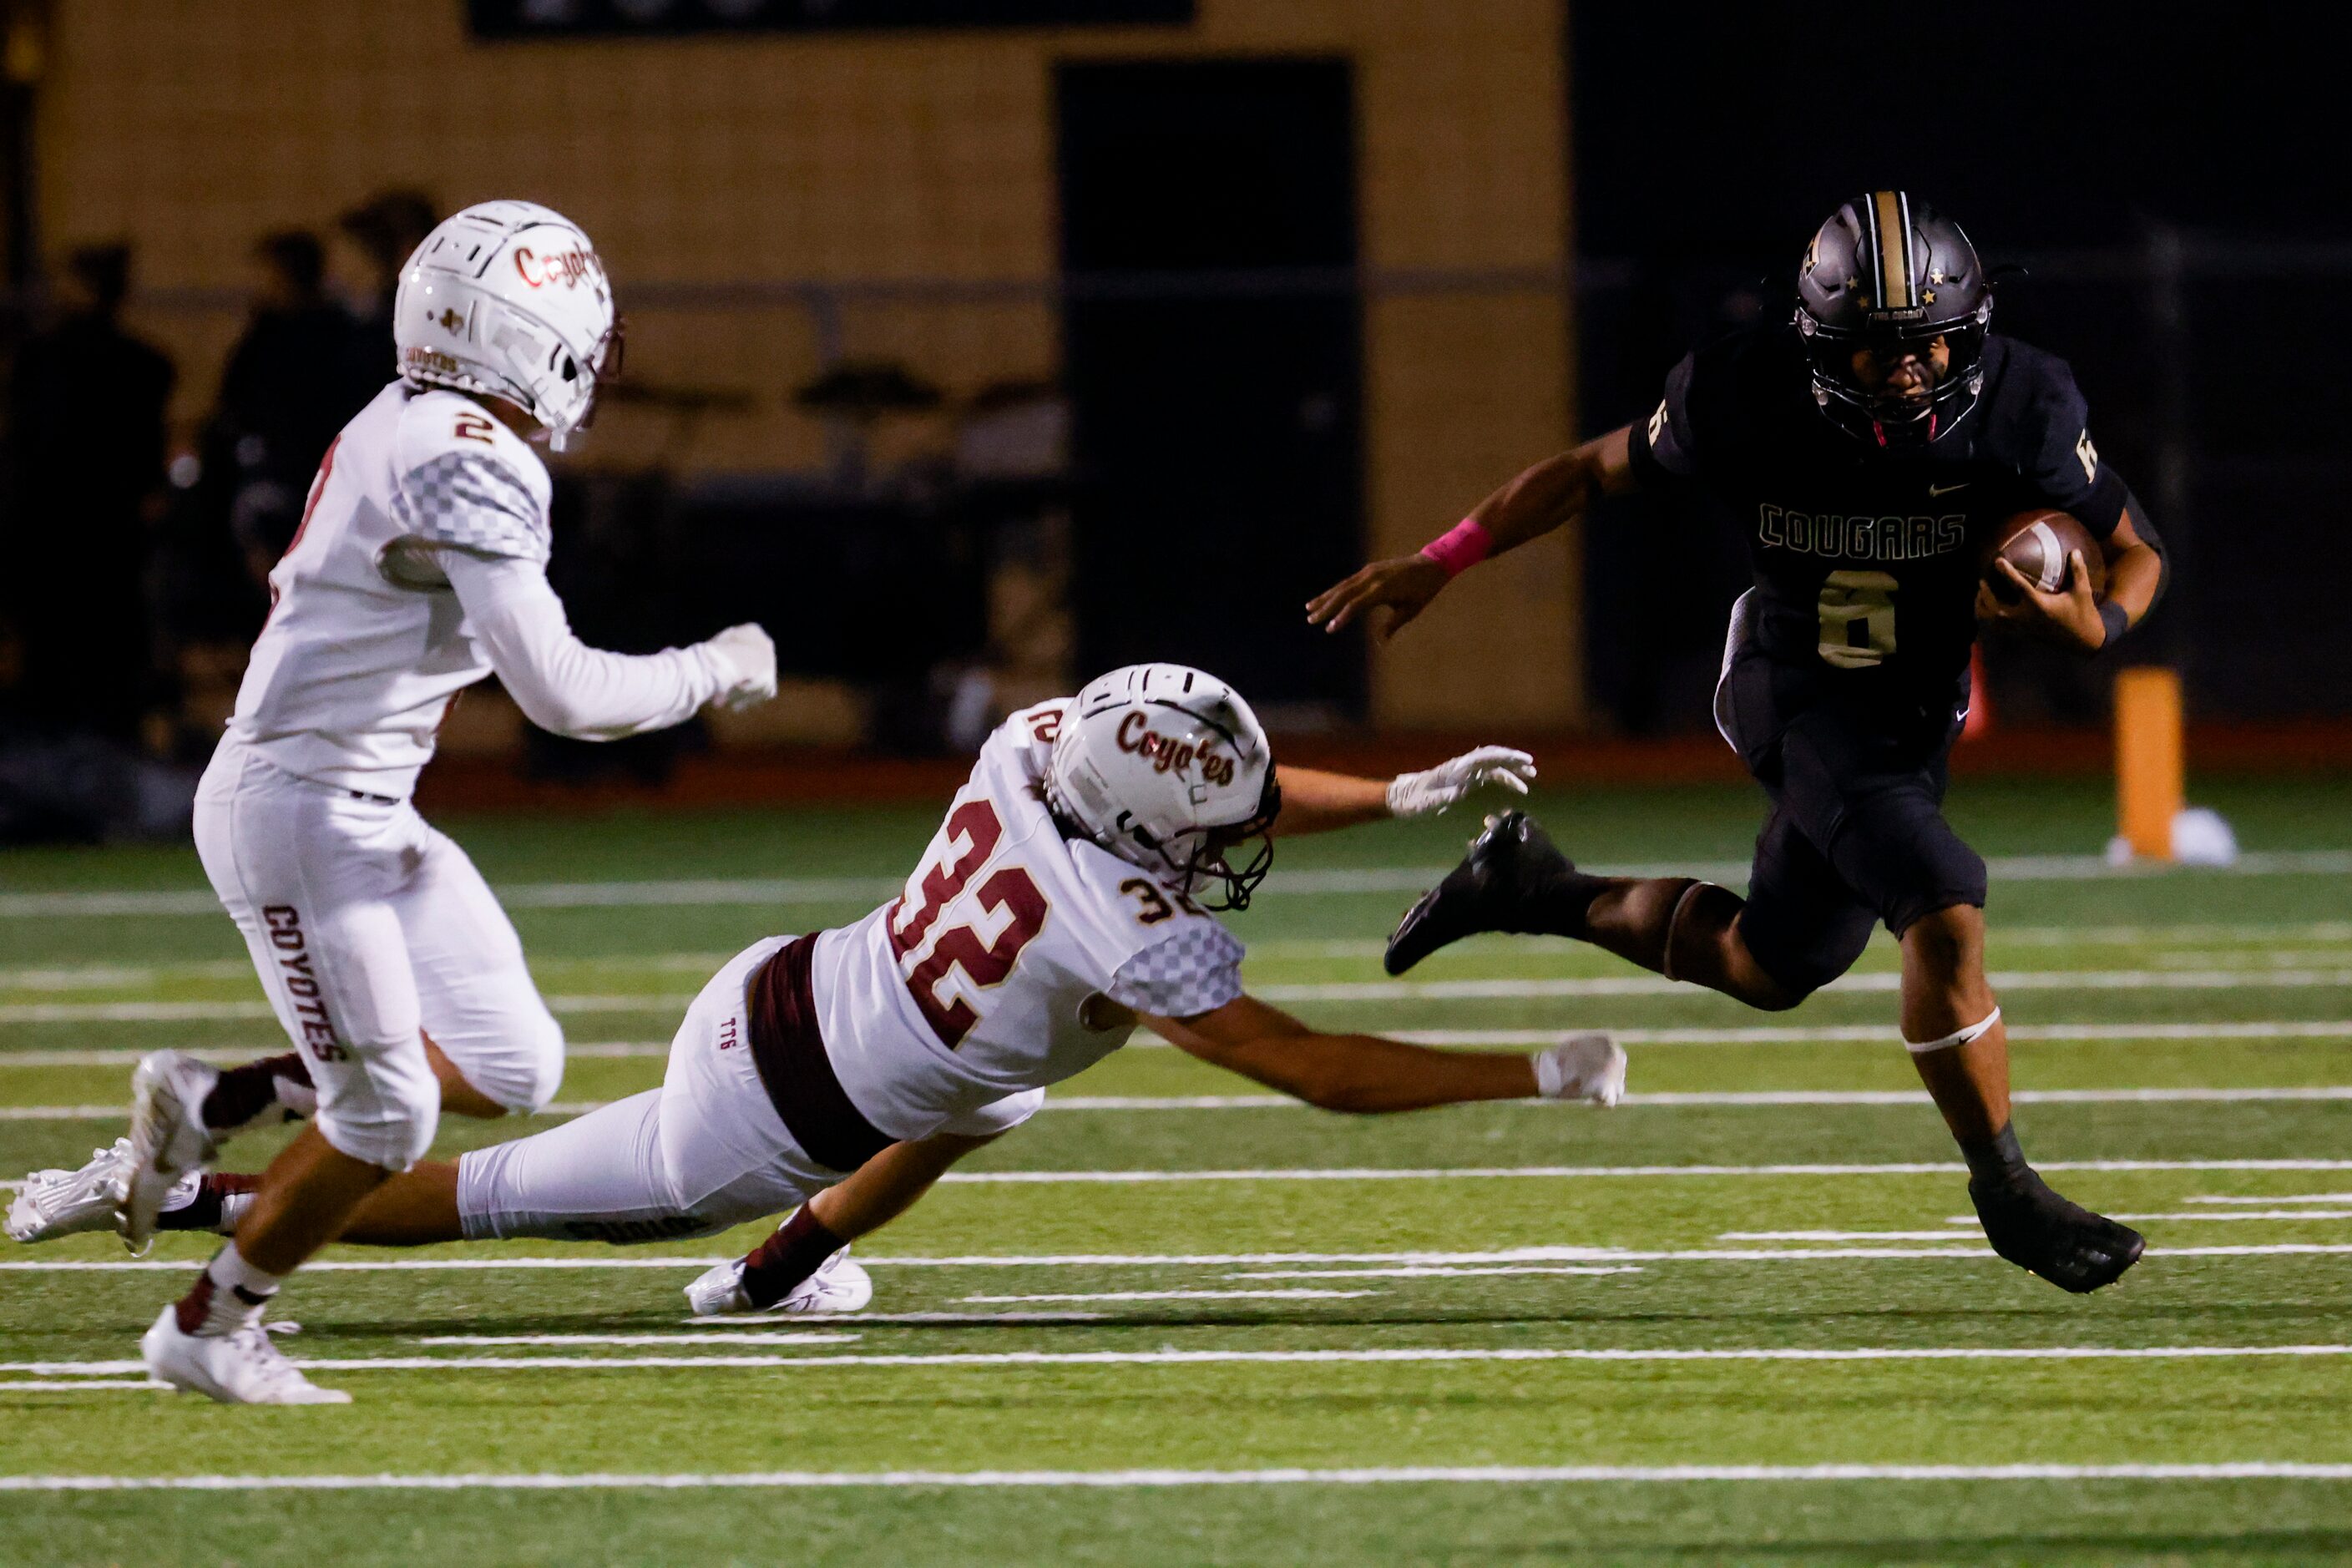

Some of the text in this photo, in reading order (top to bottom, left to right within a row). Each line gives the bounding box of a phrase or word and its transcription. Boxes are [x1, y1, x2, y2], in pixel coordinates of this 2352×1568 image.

[455, 412, 493, 445] 2
[1759, 503, 1966, 560] COUGARS
[887, 799, 1051, 1050] 32
[263, 904, 347, 1062] COYOTES
